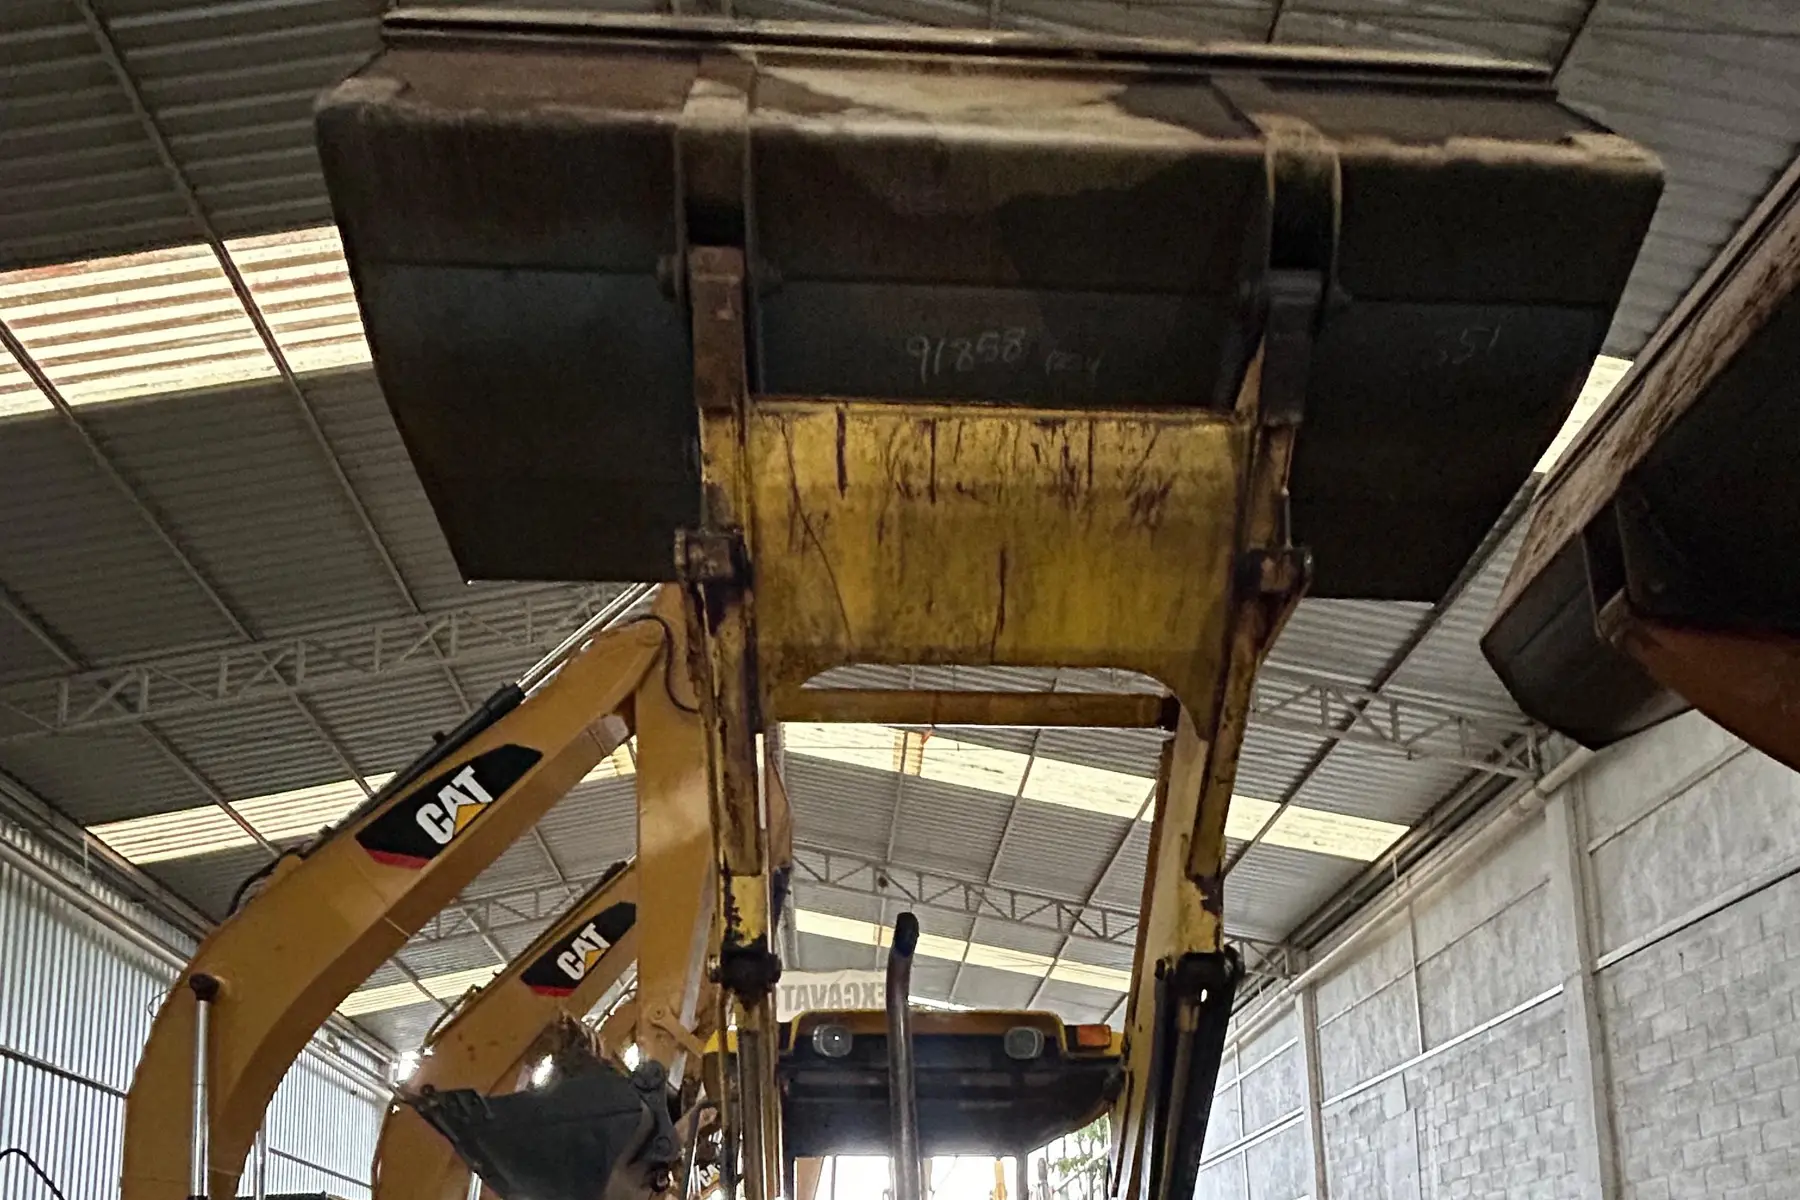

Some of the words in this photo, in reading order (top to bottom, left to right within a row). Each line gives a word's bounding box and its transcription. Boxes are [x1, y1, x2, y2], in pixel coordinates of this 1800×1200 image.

[415, 765, 494, 845] CAT
[556, 922, 611, 981] CAT
[700, 1164, 721, 1187] CA
